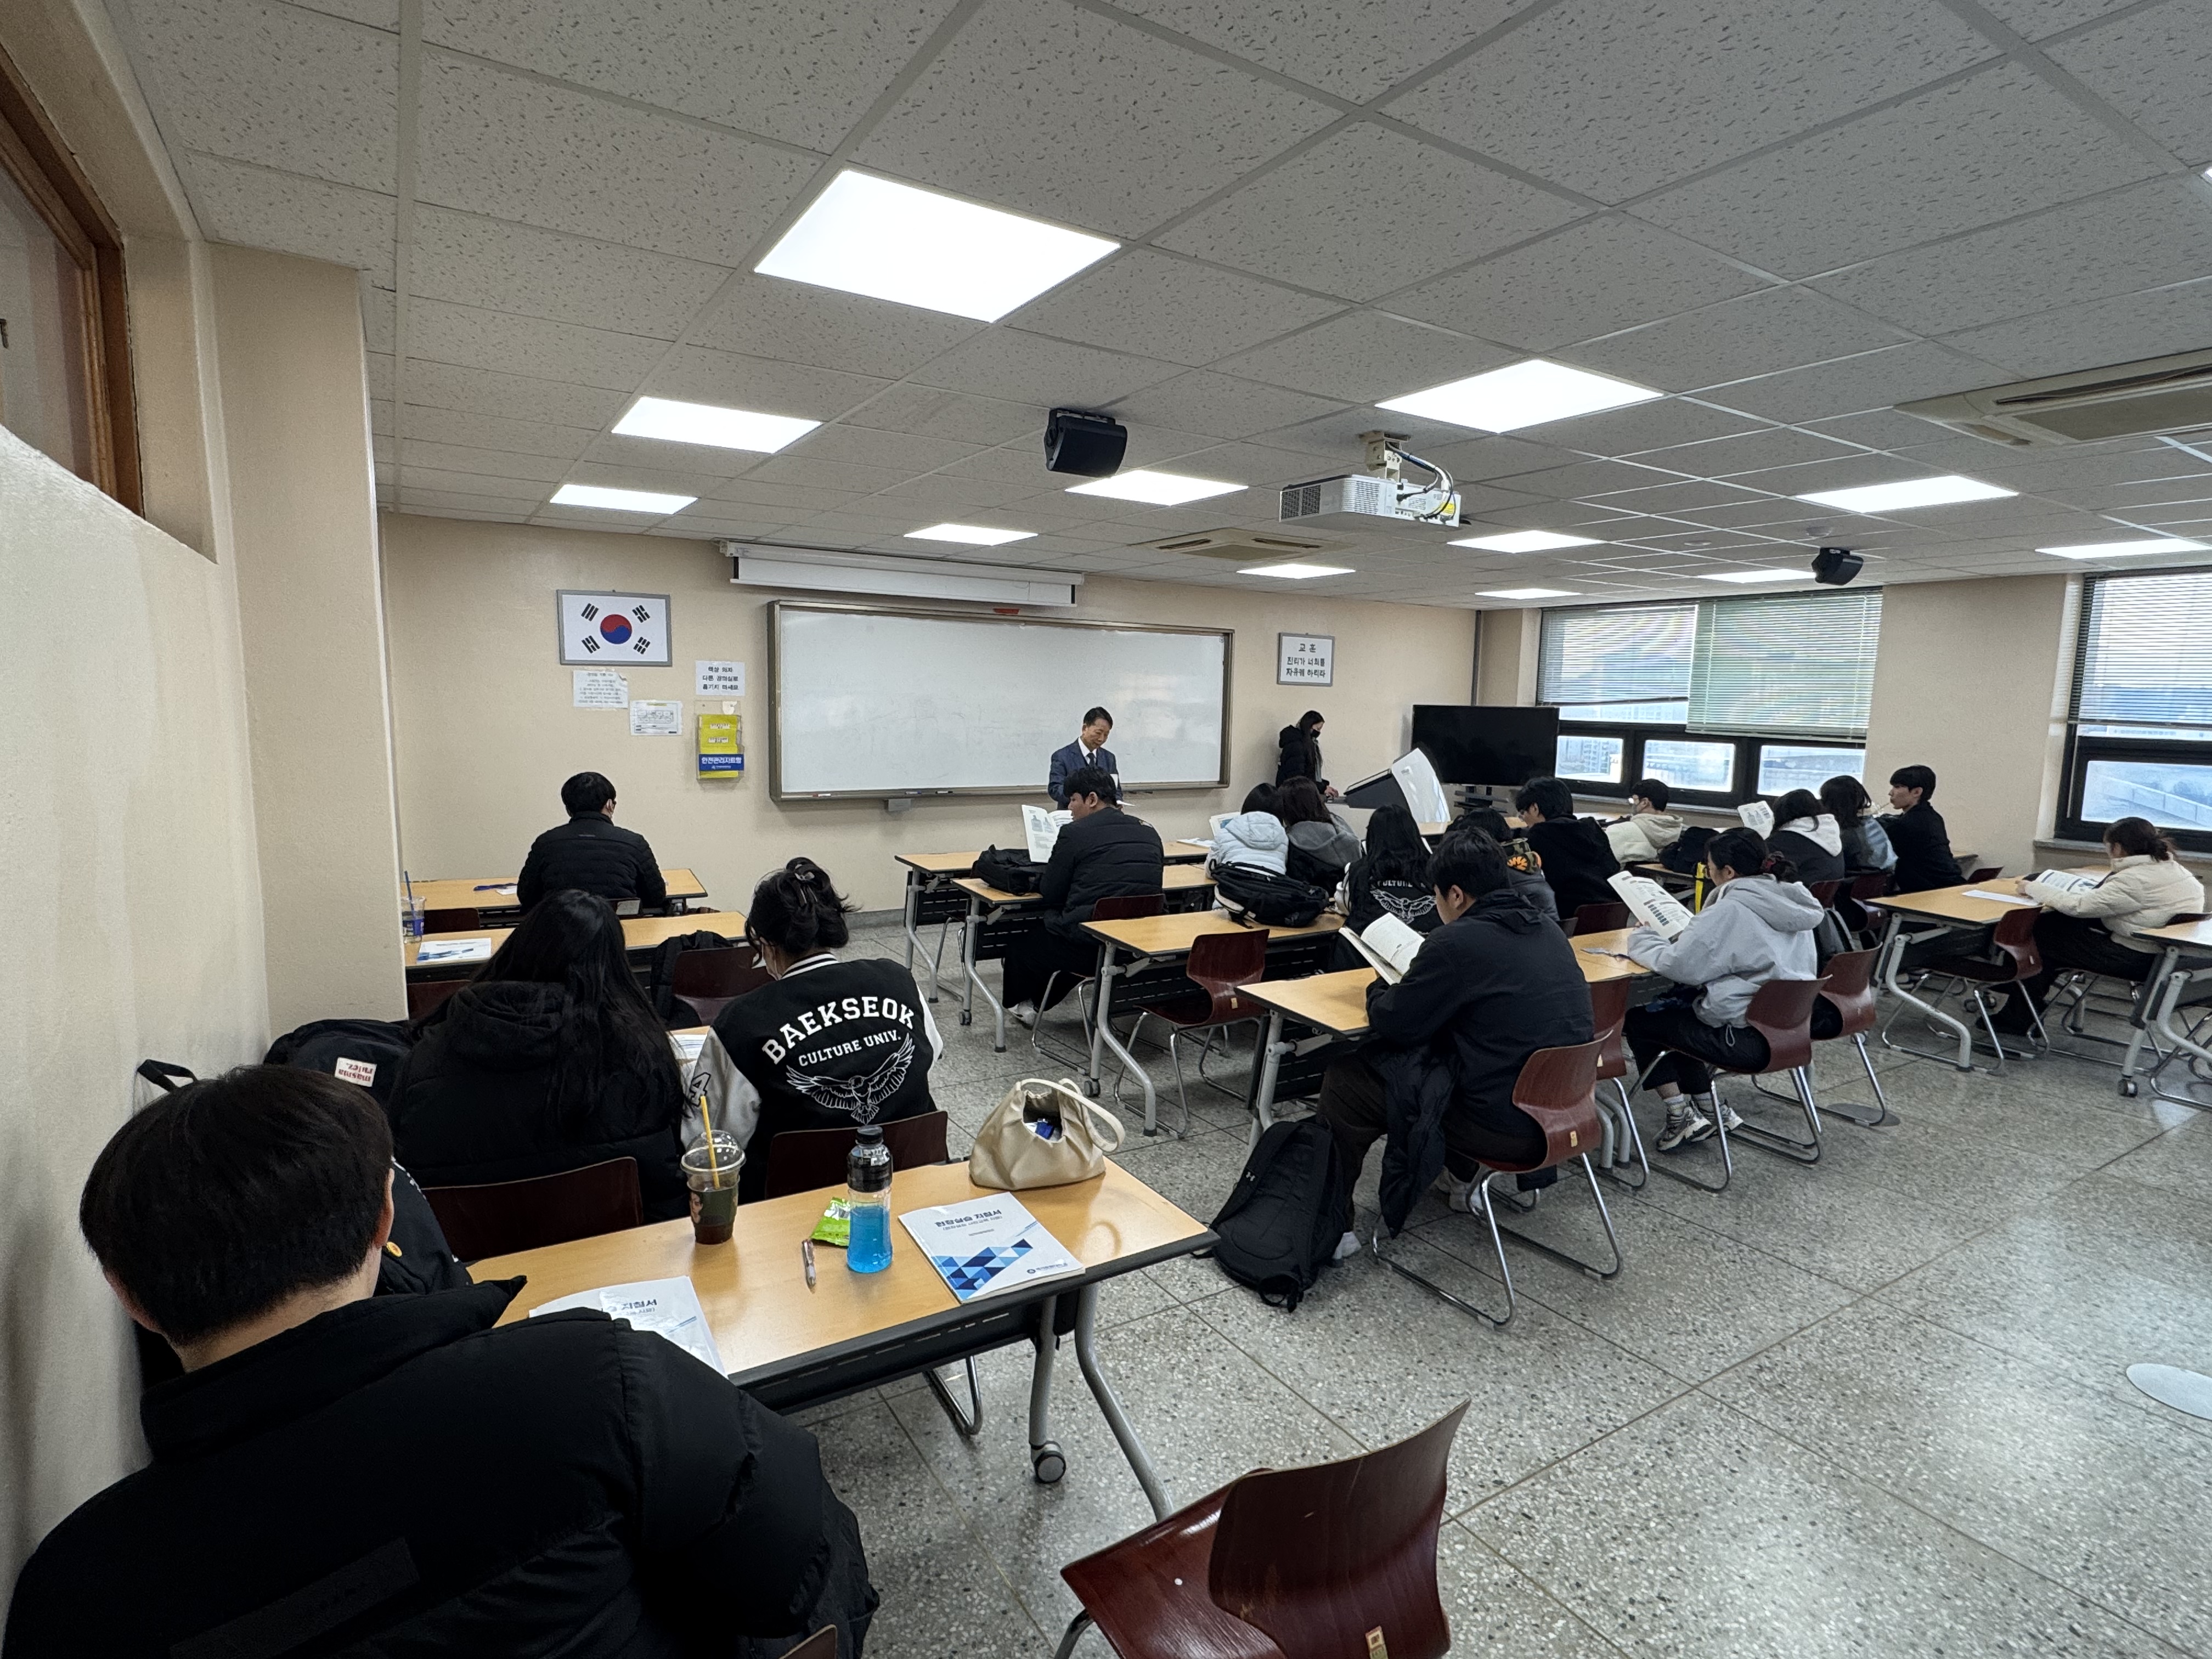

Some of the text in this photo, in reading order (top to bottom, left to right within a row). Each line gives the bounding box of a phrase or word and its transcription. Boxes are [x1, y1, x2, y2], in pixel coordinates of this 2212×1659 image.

[1298, 643, 1316, 653] 교 훈
[1286, 656, 1325, 667] 진리가 너희를
[1307, 668, 1326, 679] 하리라
[761, 996, 915, 1065] BAEKSEOK
[799, 1030, 901, 1066] CULTURE UNIV.
